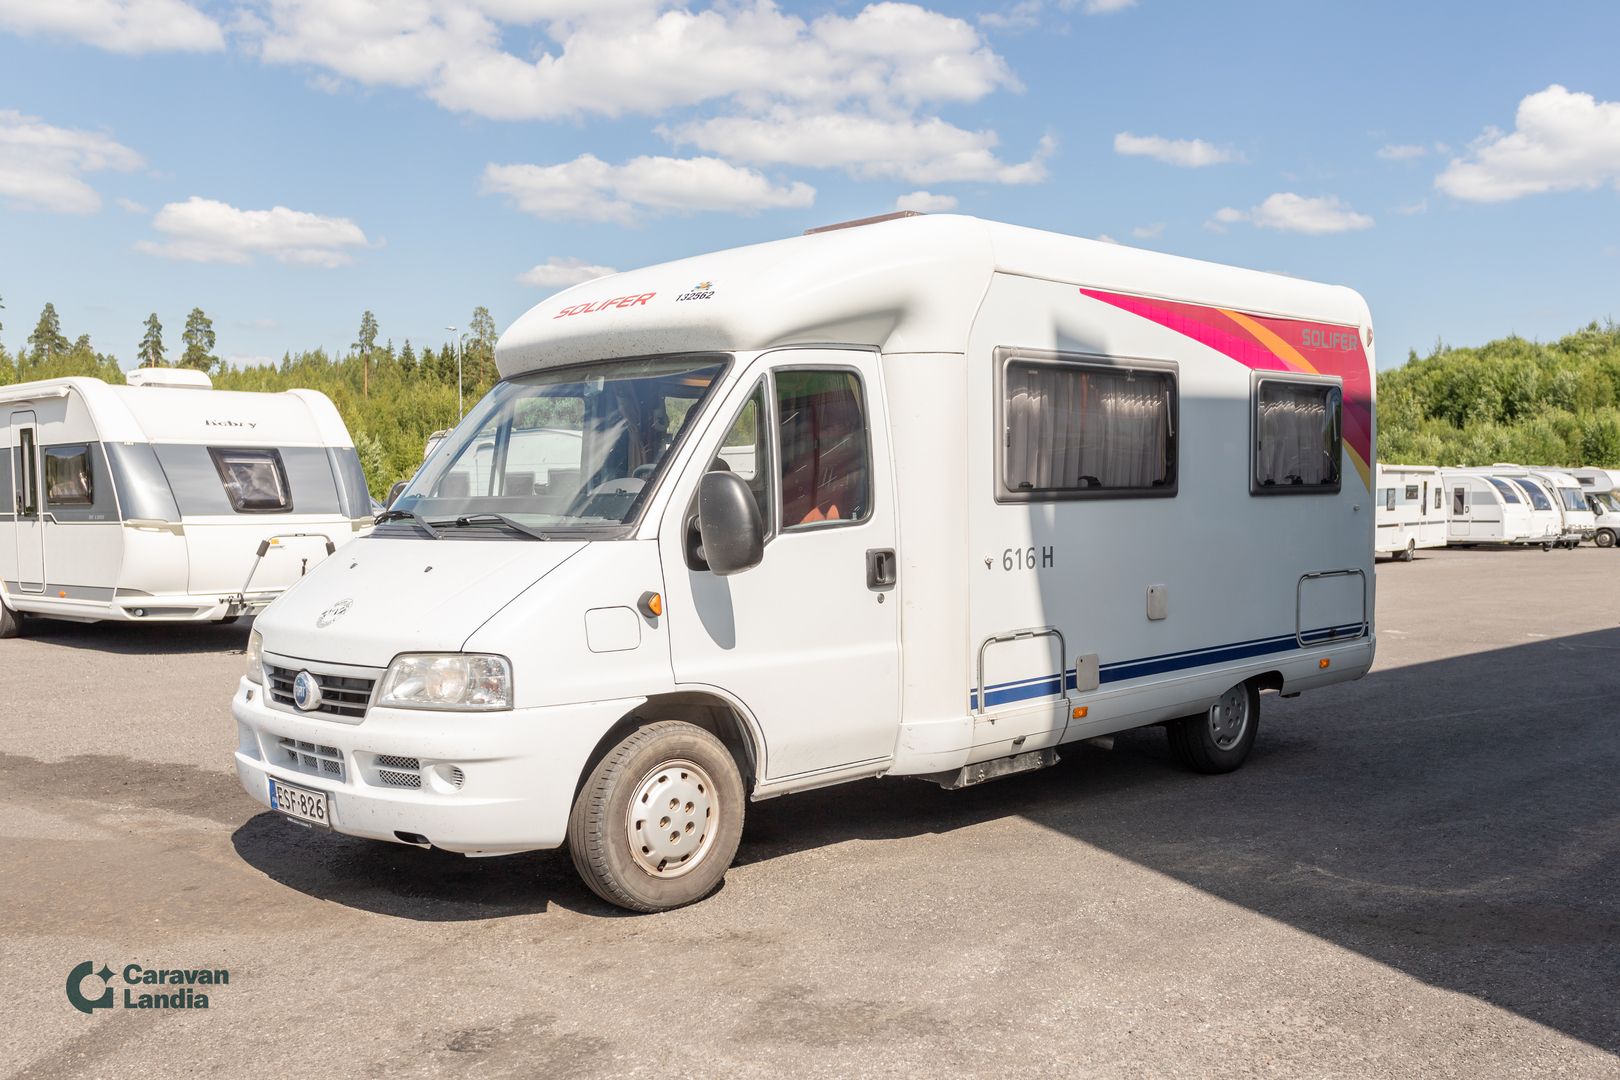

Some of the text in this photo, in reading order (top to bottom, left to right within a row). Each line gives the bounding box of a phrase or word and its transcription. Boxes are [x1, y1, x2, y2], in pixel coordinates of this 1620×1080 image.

[553, 292, 657, 320] SOLIFER
[676, 291, 715, 302] 132562
[1302, 328, 1358, 352] SOLIFER
[1002, 545, 1054, 571] 616 H
[277, 786, 324, 819] ESF-826
